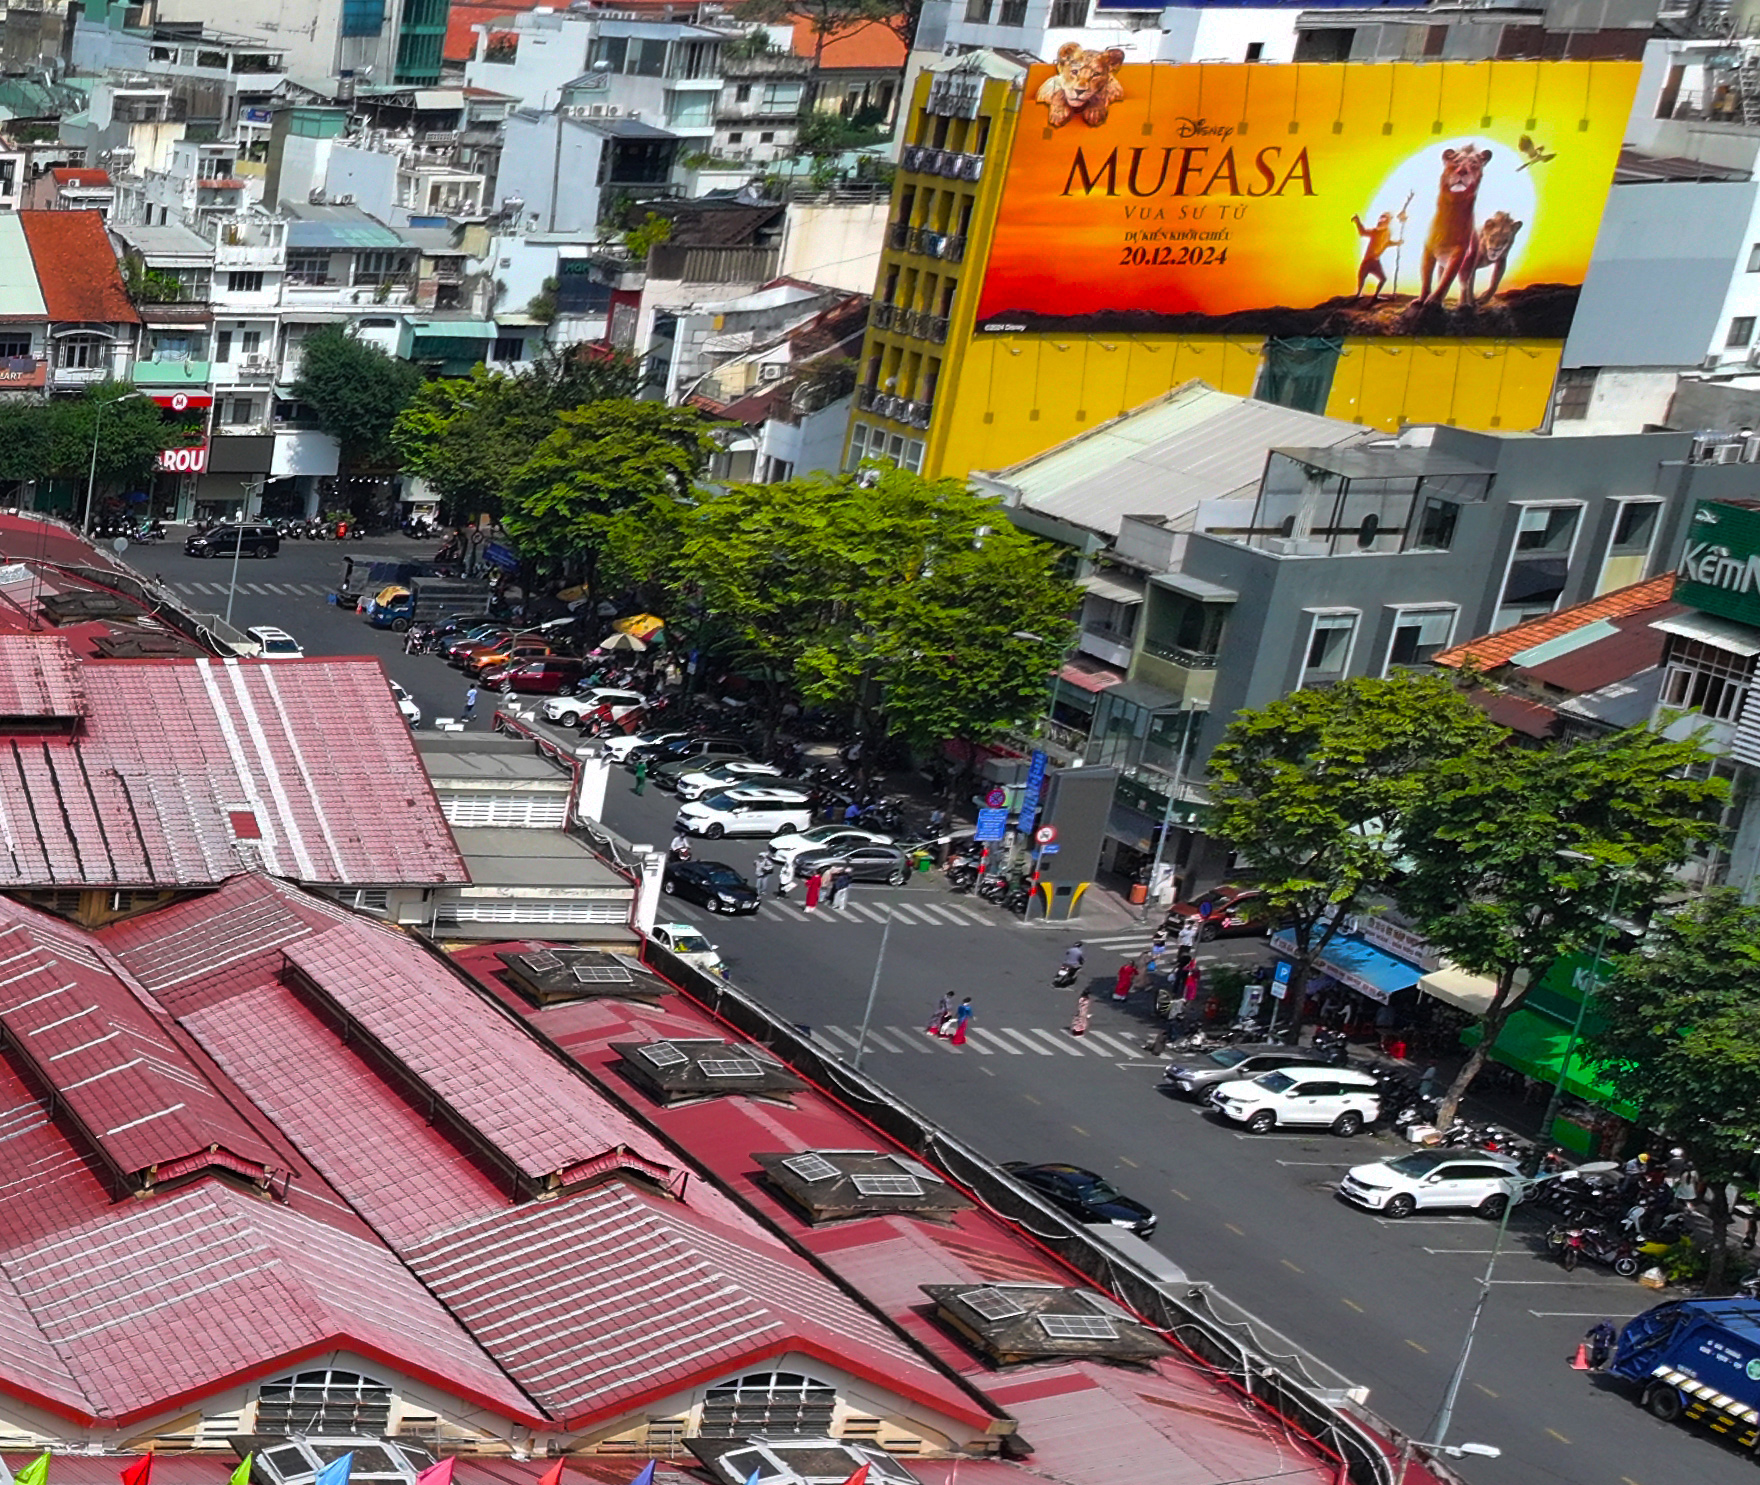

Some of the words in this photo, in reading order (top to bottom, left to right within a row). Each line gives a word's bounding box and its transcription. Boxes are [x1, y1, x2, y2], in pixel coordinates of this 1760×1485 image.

[1059, 146, 1319, 197] MUFASA
[1124, 205, 1165, 220] VUA
[1178, 205, 1207, 220] SƯ
[1219, 203, 1248, 220] TỬ
[1119, 246, 1229, 266] 20.12.2024
